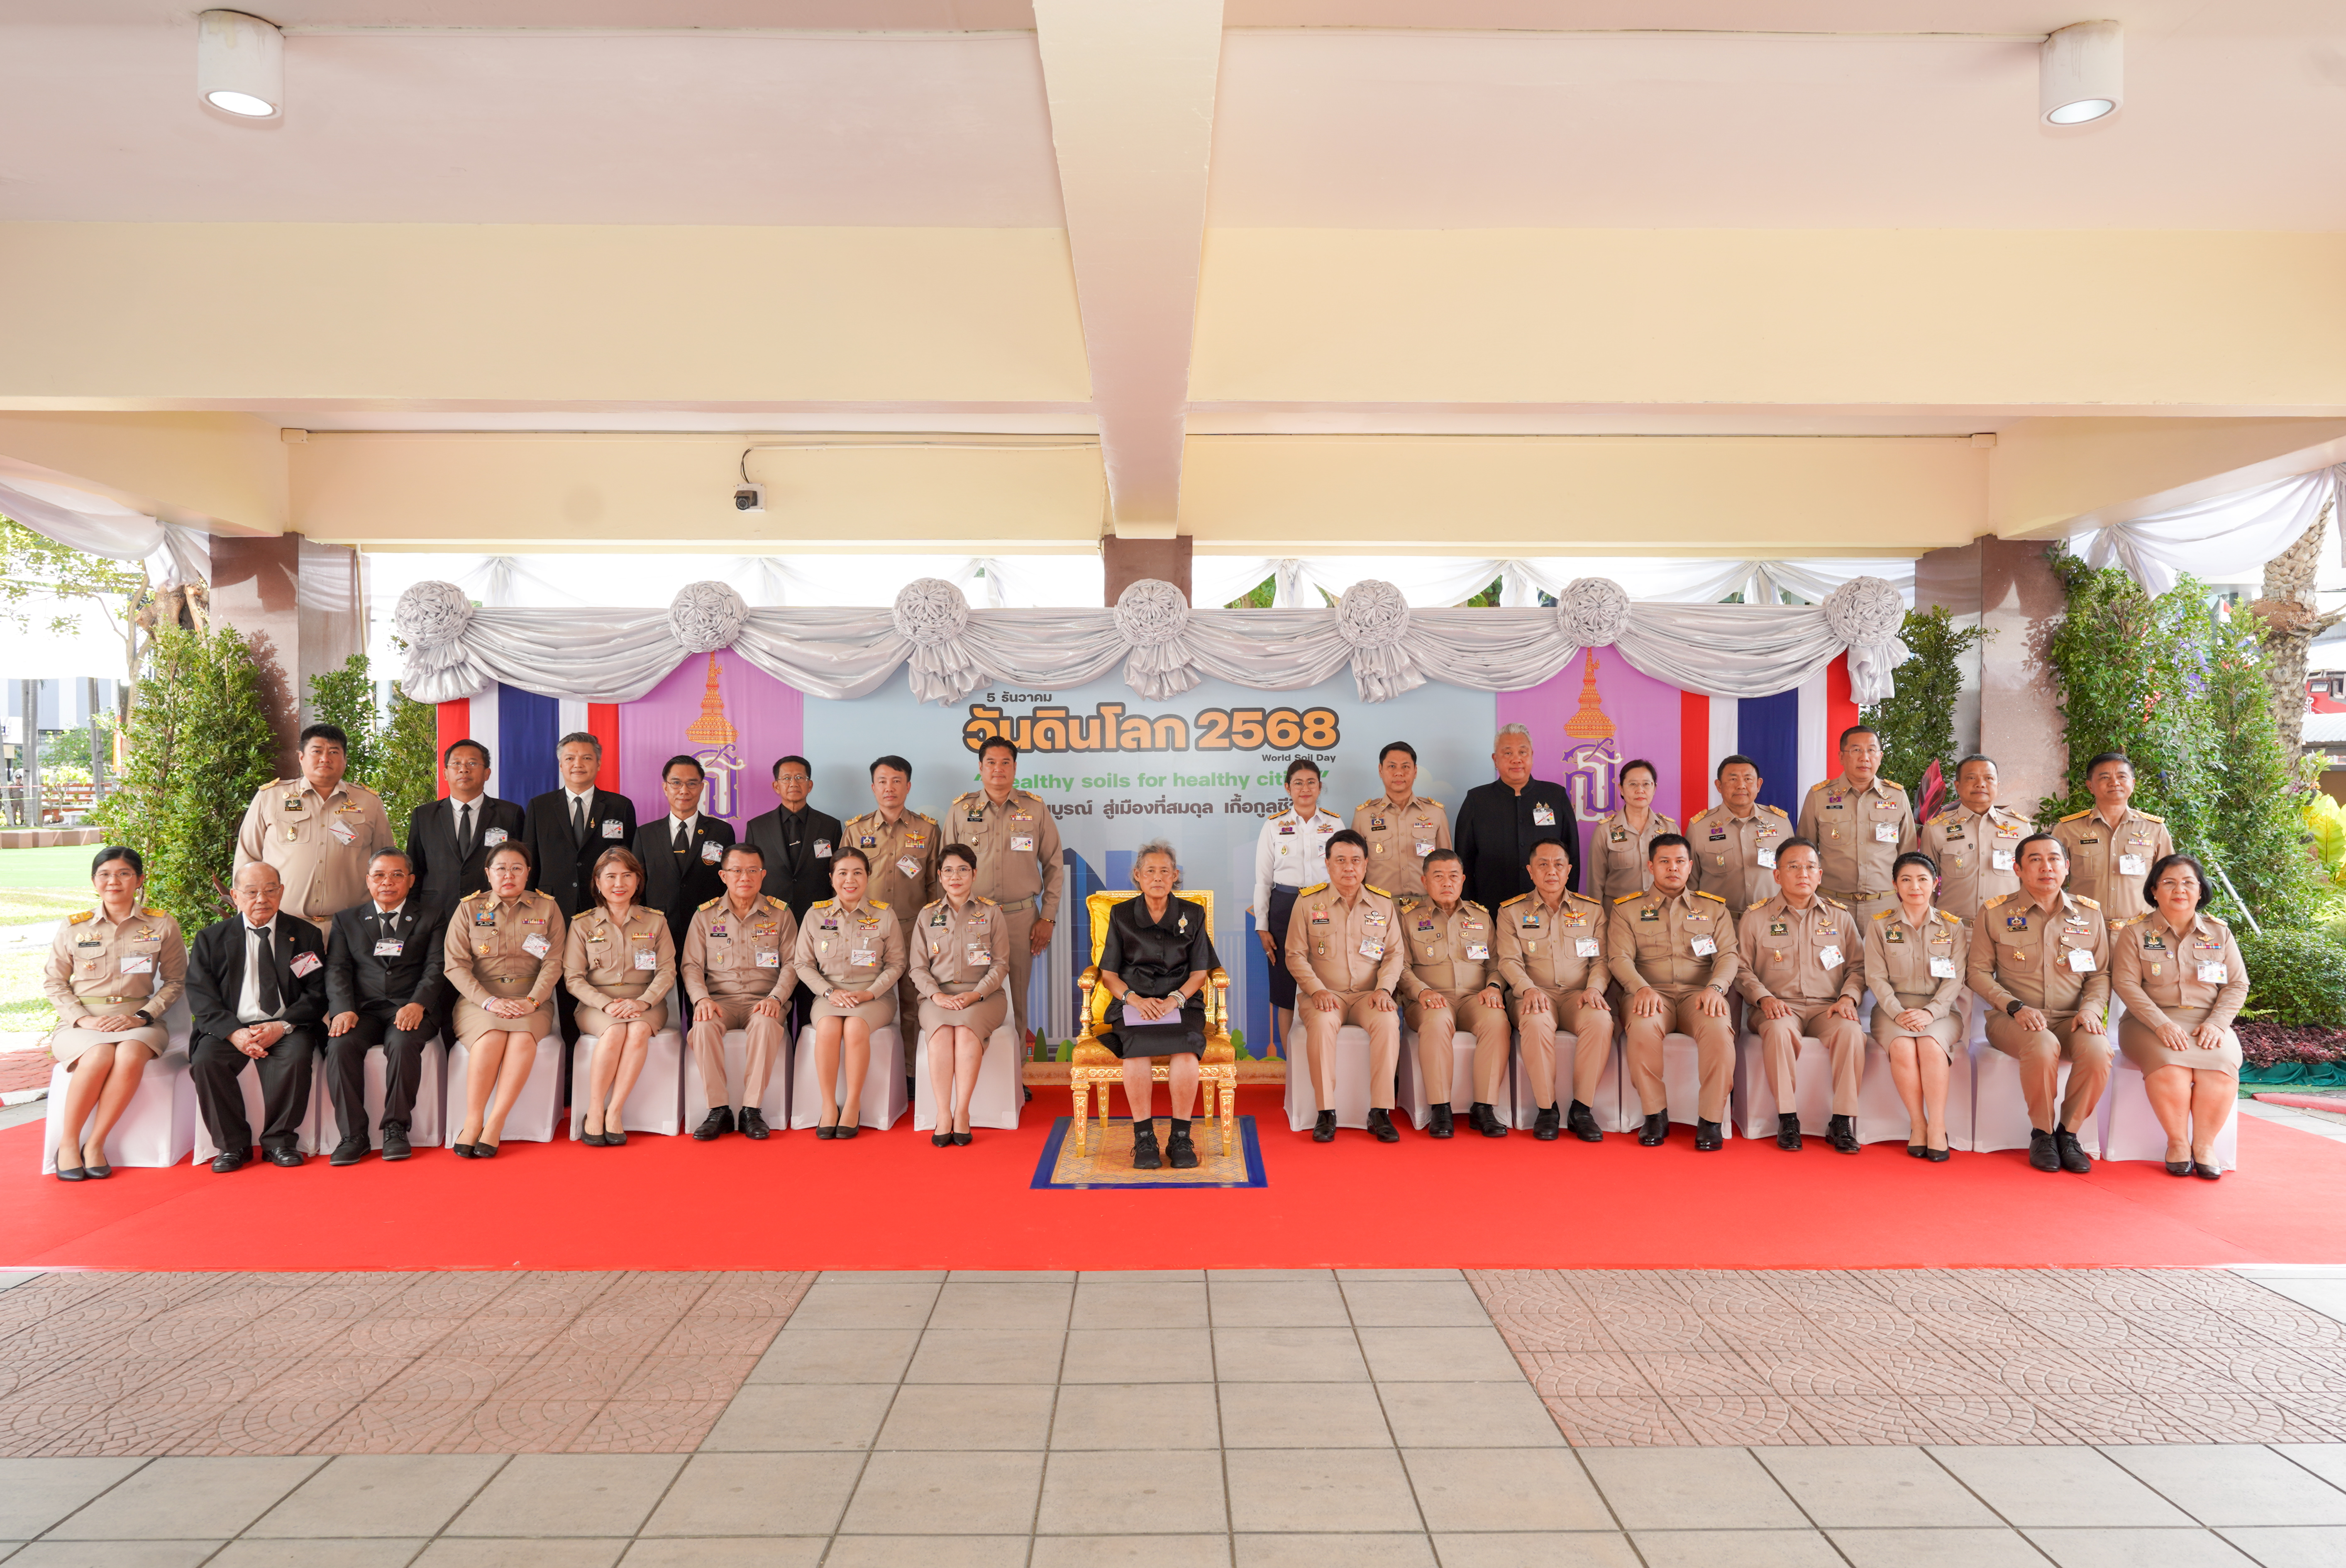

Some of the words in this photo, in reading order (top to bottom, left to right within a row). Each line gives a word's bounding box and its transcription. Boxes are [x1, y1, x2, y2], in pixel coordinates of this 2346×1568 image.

[987, 693, 996, 702] 5
[1001, 691, 1052, 702] ธันวาคม
[963, 702, 1189, 752] วันดินโลก
[1194, 707, 1340, 751] 2568
[1316, 754, 1336, 763] Day
[1081, 773, 1130, 788] soils
[1137, 773, 1167, 787] for
[1173, 772, 1250, 790] healthy
[1103, 795, 1213, 819] สู่เมืองที่สมดุล
